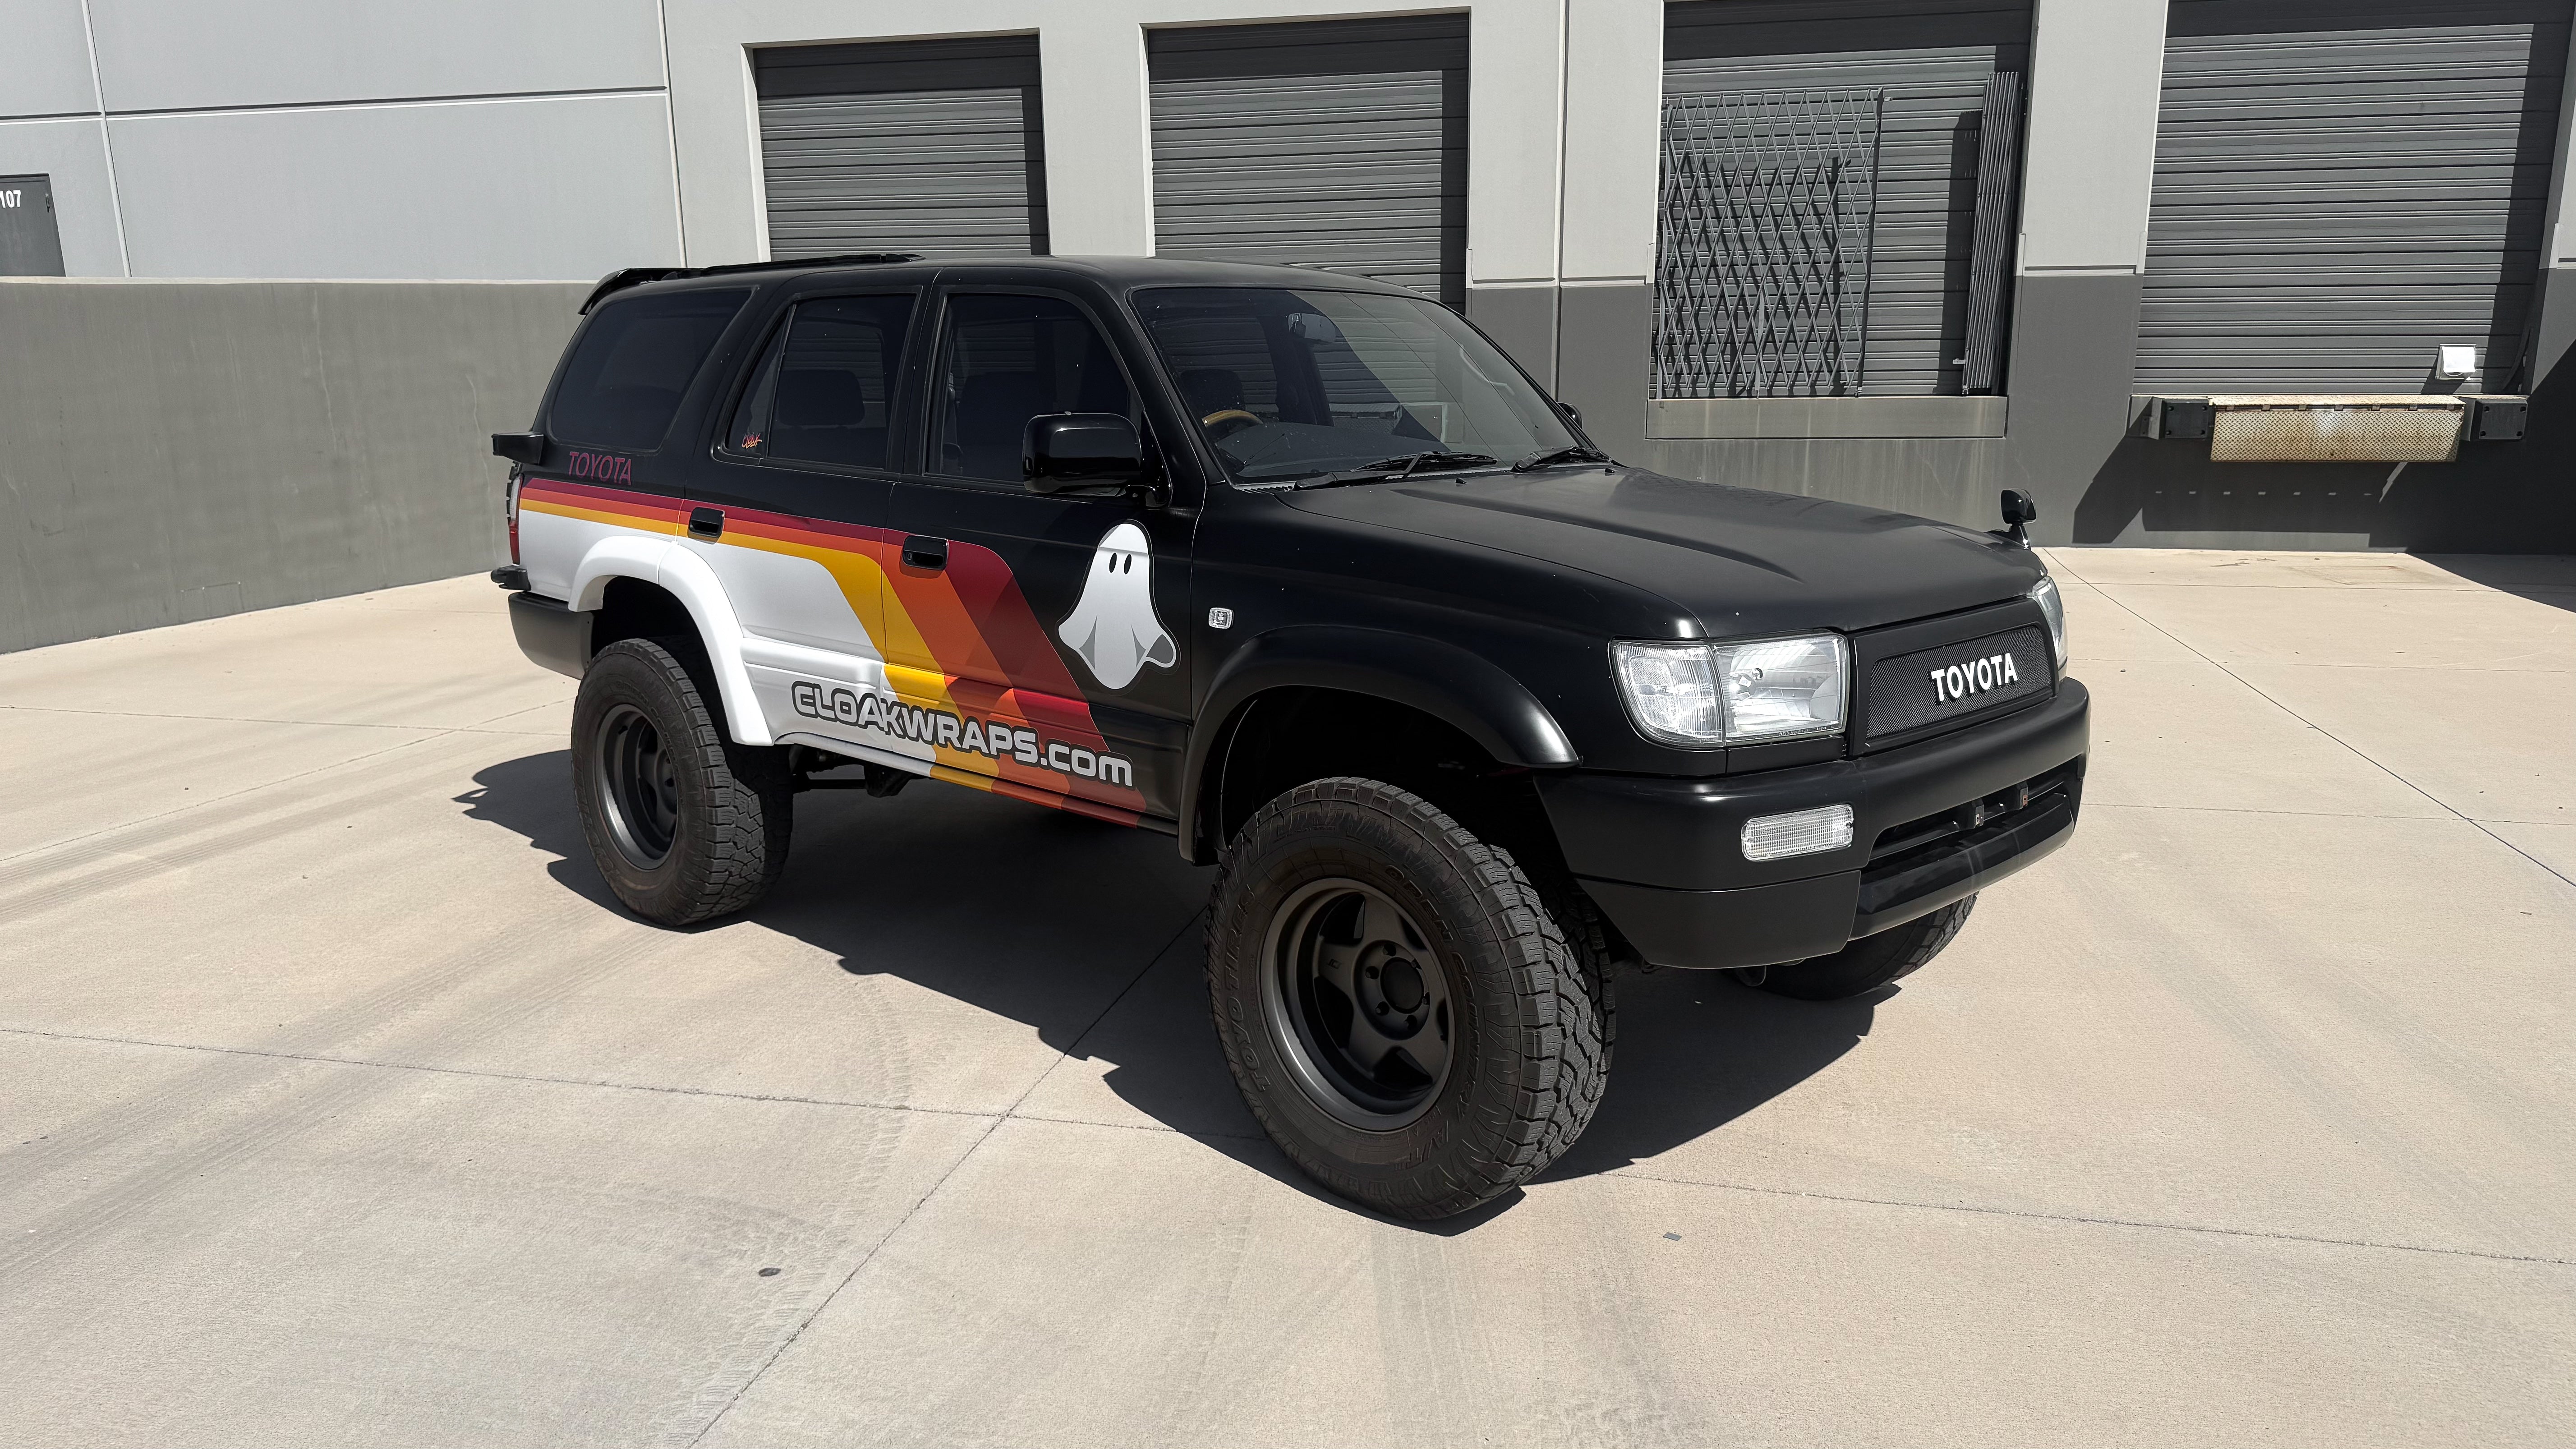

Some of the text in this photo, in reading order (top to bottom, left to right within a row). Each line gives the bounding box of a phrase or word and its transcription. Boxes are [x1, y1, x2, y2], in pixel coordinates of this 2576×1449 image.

[0, 190, 21, 208] 107
[568, 451, 631, 486] TOYOTA
[1931, 653, 2019, 702] TOYOTA
[1226, 995, 1271, 1093] TOYO
